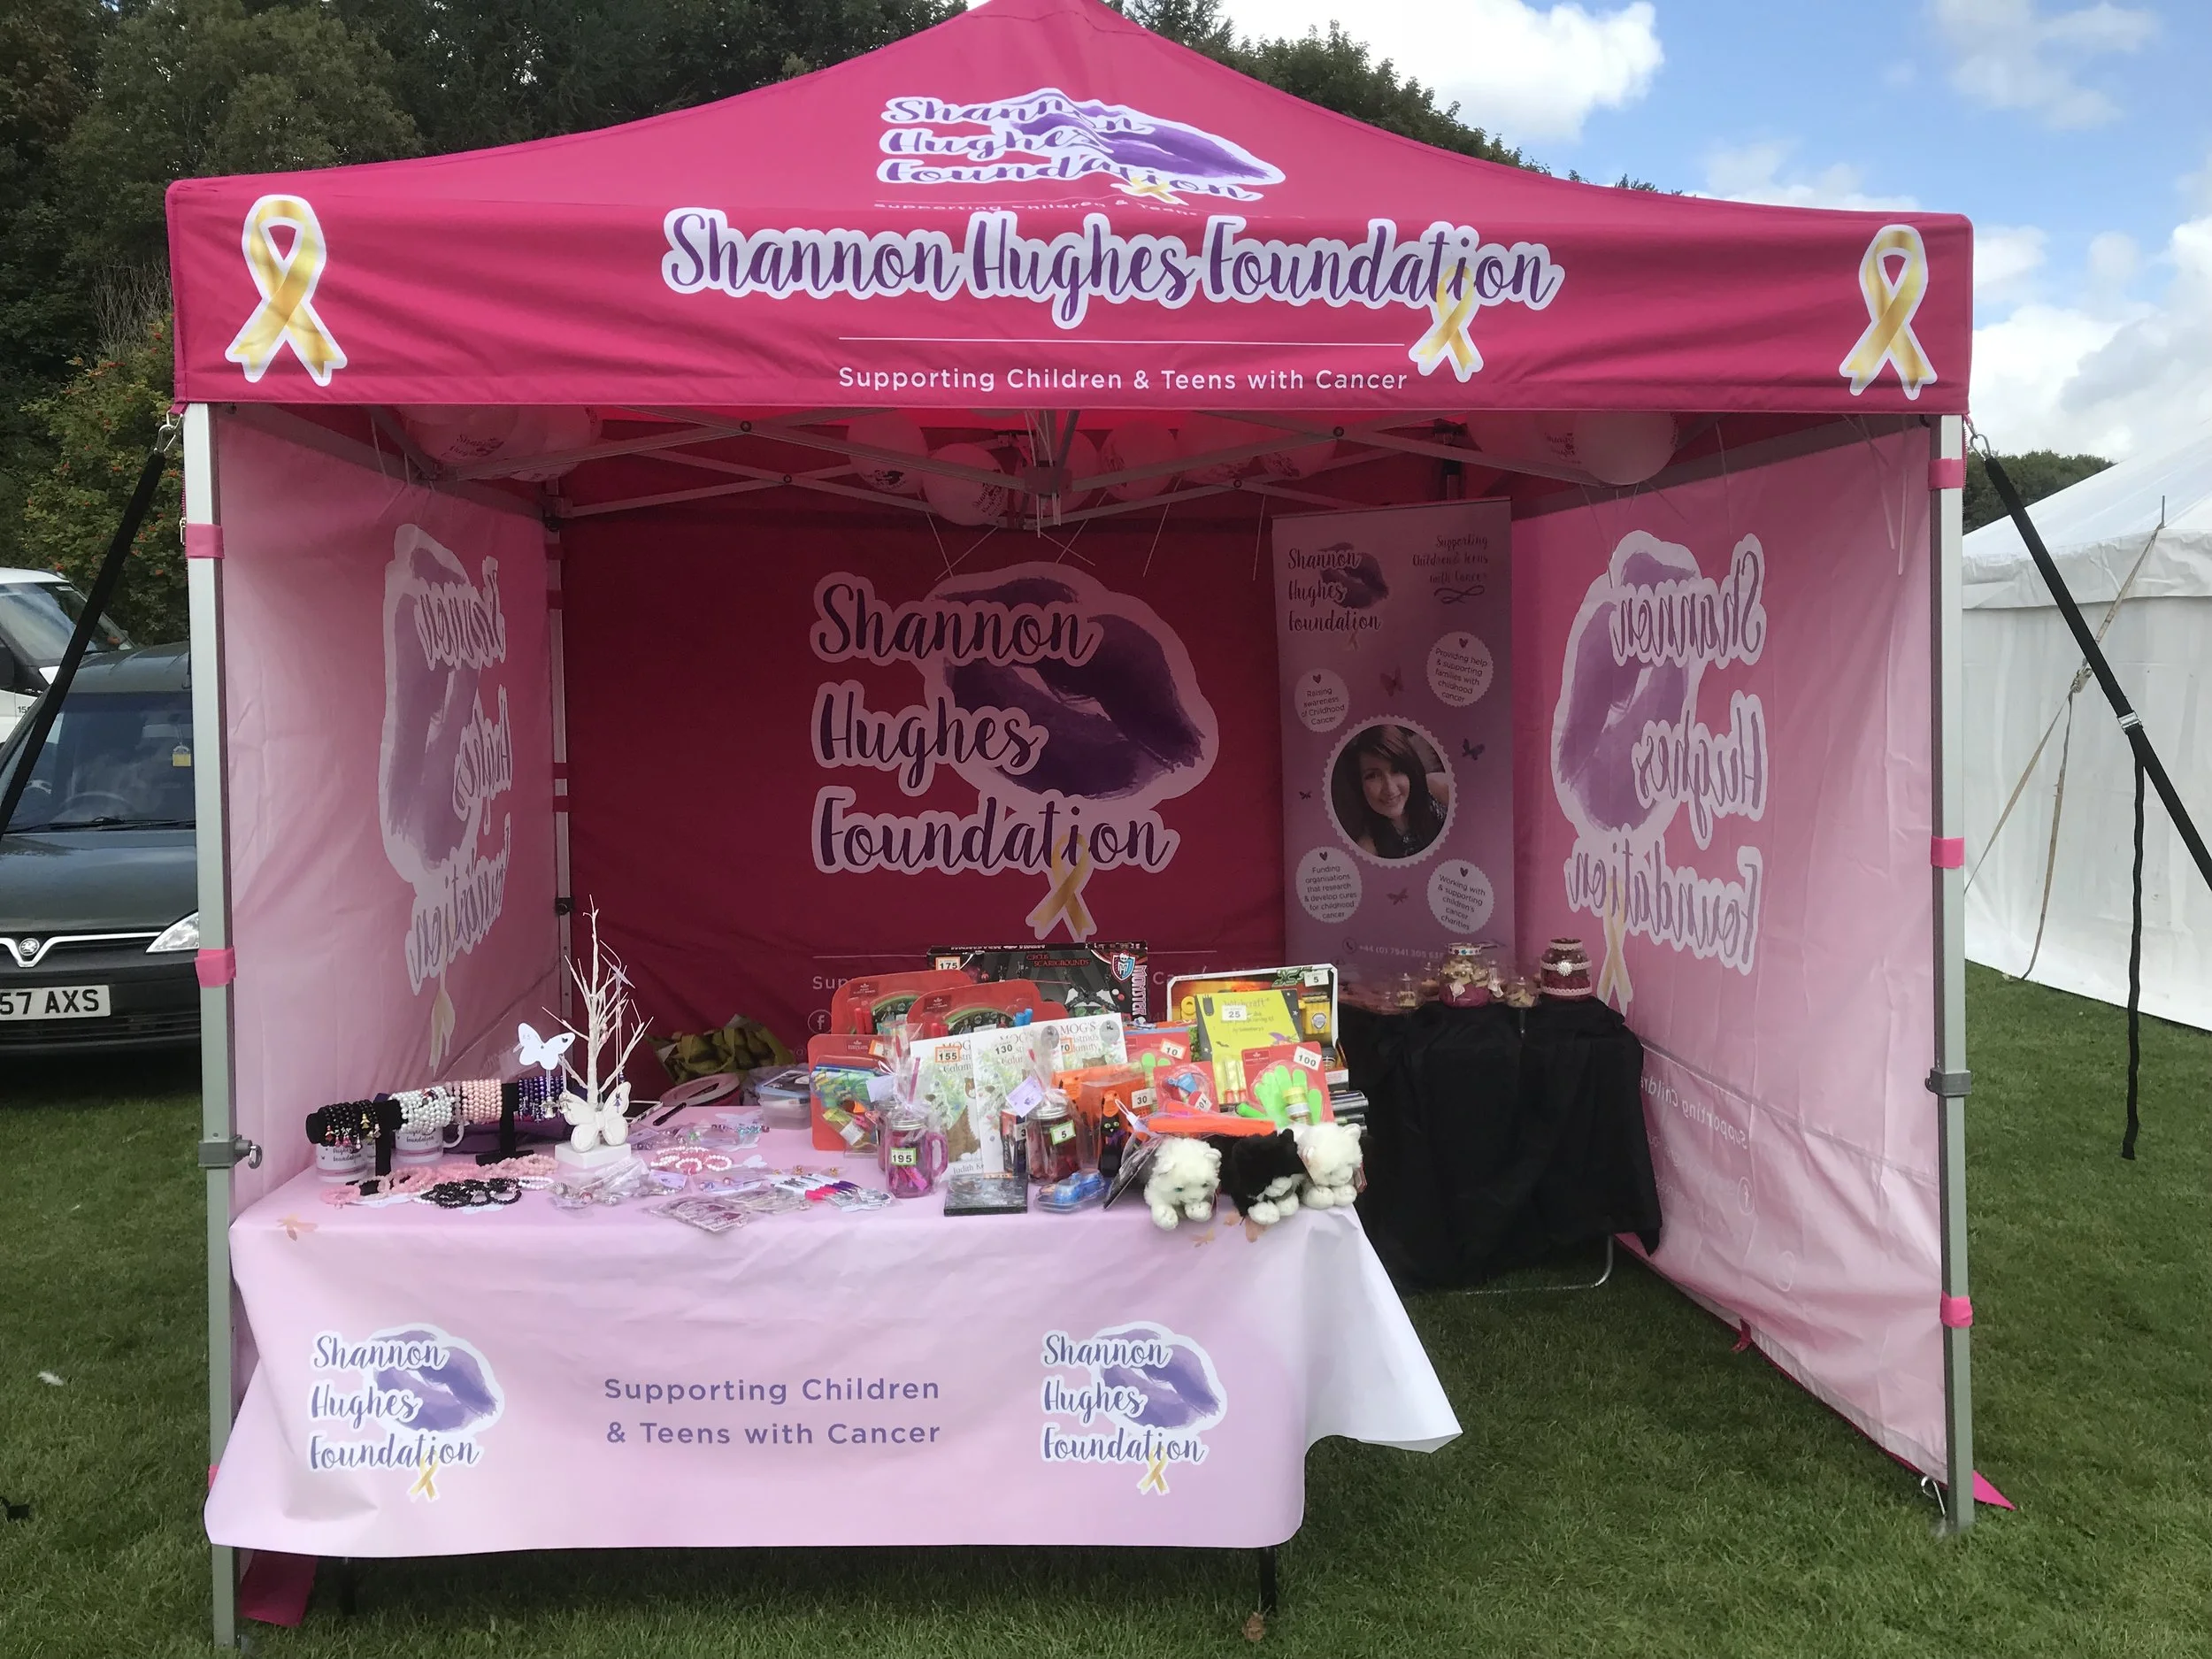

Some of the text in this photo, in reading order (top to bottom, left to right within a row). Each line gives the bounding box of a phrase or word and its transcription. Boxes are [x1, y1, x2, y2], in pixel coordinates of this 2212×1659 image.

[887, 128, 1112, 159] Hughes
[886, 156, 1262, 200] Foundation
[669, 212, 1556, 322] Shannon Hughes Foundation
[839, 366, 1409, 393] Supporting Children & Teens with Cancer
[1287, 548, 1359, 570] Shannon
[1288, 579, 1344, 608] Hughes
[818, 582, 1097, 660] Shannon
[1288, 609, 1381, 632] Foundation
[1435, 647, 1488, 667] Providing help
[1442, 661, 1483, 677] supporting
[1463, 677, 1479, 686] with
[819, 692, 1041, 788] Hughes
[819, 795, 1171, 868] Foundation
[1305, 873, 1351, 884] organisations
[1311, 865, 1340, 874] Funding
[1322, 883, 1351, 892] research
[1439, 873, 1486, 896] Working with
[1310, 894, 1338, 902] develop
[1320, 901, 1355, 910] childhood
[1442, 896, 1475, 913] children's
[1445, 887, 1483, 907] supporting
[1445, 907, 1469, 920] cancer
[1131, 964, 1148, 1017] MONSTER
[0, 988, 100, 1016] 57 AXS
[1060, 1021, 1096, 1035] MOG'S
[939, 1052, 957, 1061] 155
[995, 1044, 1013, 1055] 130
[1165, 1047, 1179, 1056] 10
[1298, 1054, 1317, 1069] 100
[1137, 1095, 1148, 1105] 30
[1061, 1130, 1067, 1139] 5
[892, 1154, 912, 1164] 195
[313, 1333, 446, 1371] Shannon
[1043, 1333, 1170, 1368] Shannon
[604, 1377, 941, 1405] Supporting Children
[311, 1383, 419, 1430] Hughes
[1044, 1381, 1145, 1424] Hughes
[606, 1422, 941, 1445] & Teens with Cancer
[1043, 1425, 1206, 1463] Foundation
[311, 1432, 480, 1471] Foundation
